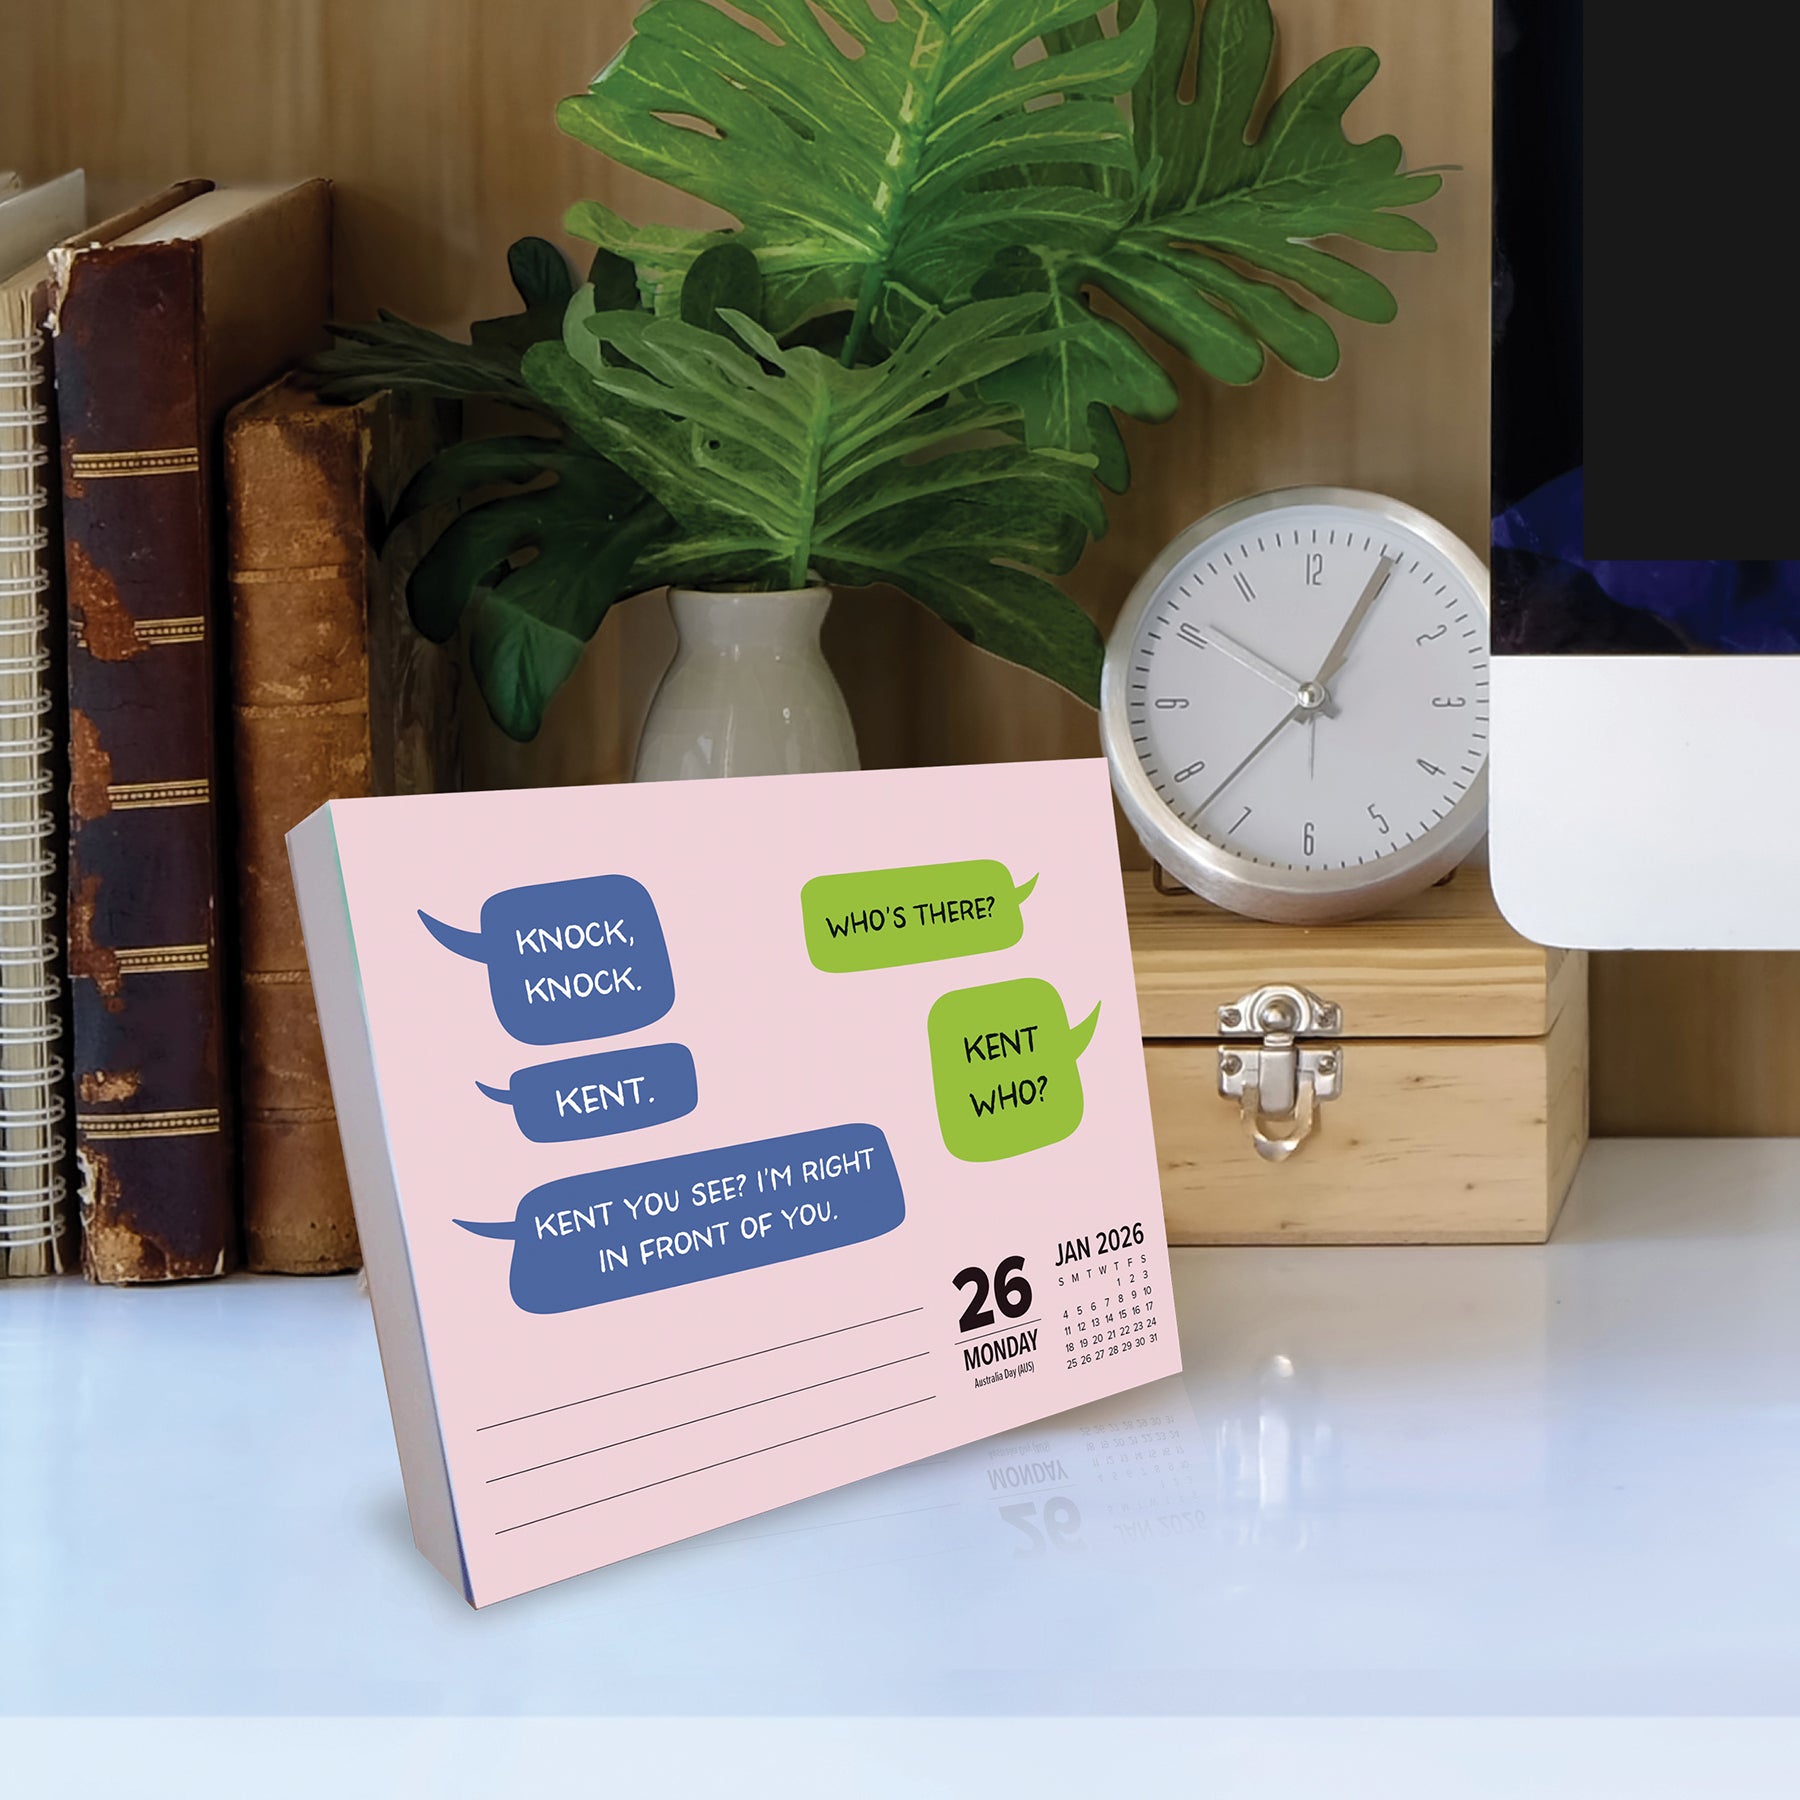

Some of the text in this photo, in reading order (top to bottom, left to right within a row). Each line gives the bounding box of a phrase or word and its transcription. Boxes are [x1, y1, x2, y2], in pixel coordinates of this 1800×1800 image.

[1233, 572, 1256, 602] 11
[1306, 553, 1323, 586] 12
[1176, 622, 1208, 650] 10
[1416, 624, 1447, 646] 2
[1154, 698, 1190, 709] 9
[1431, 696, 1466, 708] 3
[1173, 760, 1206, 784] 8
[1416, 757, 1447, 777] 4
[1227, 806, 1252, 835] 7
[1367, 803, 1390, 835] 5
[1303, 822, 1315, 857] 6
[825, 896, 996, 938] WHO'S THERE?
[515, 918, 635, 955] KNOCK,
[524, 966, 642, 1005] KNOCK.
[963, 1025, 1039, 1064] KENT
[555, 1076, 655, 1118] KENT.
[968, 1074, 1048, 1118] WHO?
[534, 1147, 875, 1240] KENT YOU SEE? I'M RIGHT
[599, 1200, 839, 1273] IN FRONT OF YOU.
[1055, 1221, 1145, 1267] JAN 2026
[1057, 1253, 1147, 1287] S M T W T F S
[1116, 1269, 1149, 1287] 1 2 3
[951, 1254, 1033, 1334] 26
[1062, 1285, 1153, 1320] 4 5 6 7 8 9 10
[1064, 1300, 1154, 1336] 11 12 13 14 15 16 17
[1065, 1316, 1157, 1353] 18 19 20 21 22 23 24
[963, 1328, 1039, 1372] MONDAY
[1066, 1332, 1158, 1370] 25 26 27 28 29 30 31
[973, 1360, 1036, 1389] Australia Day (AUS)
